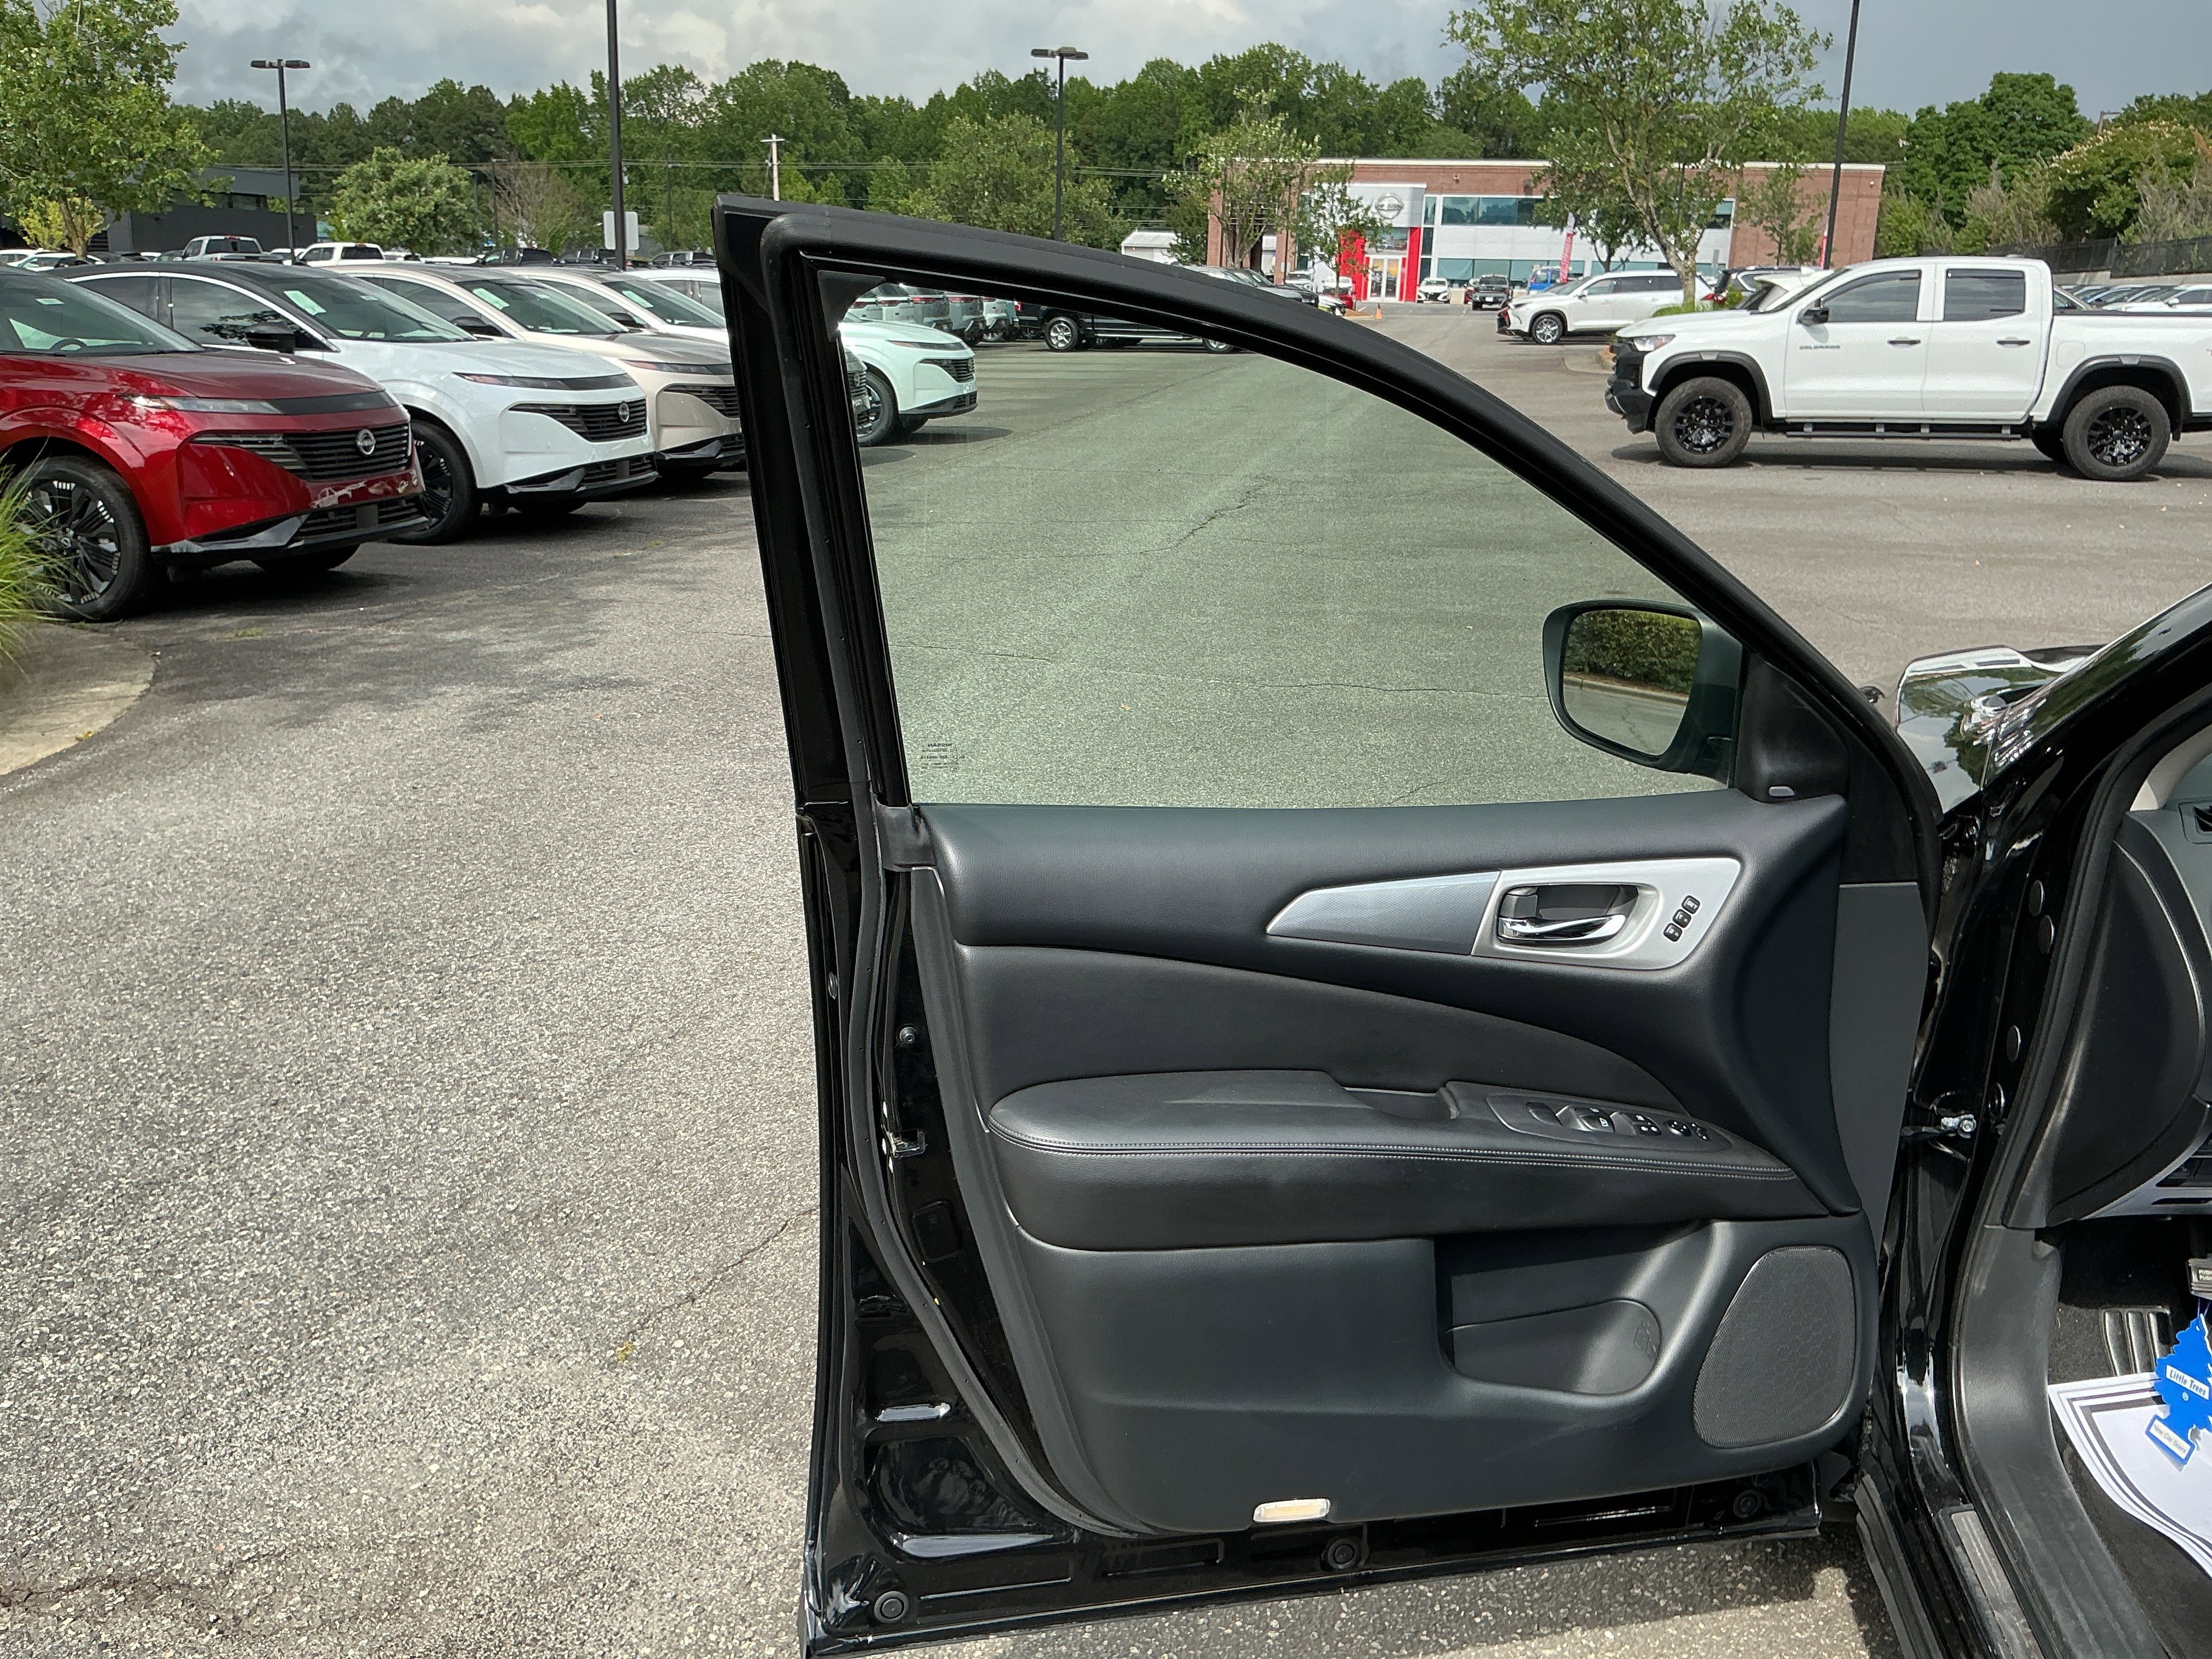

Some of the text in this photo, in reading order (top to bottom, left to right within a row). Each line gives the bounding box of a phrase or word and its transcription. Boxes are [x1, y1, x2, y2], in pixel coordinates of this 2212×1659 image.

[1686, 900, 1699, 910] SET
[2169, 1369, 2207, 1396] Little Trees
[2164, 1432, 2173, 1443] Car
